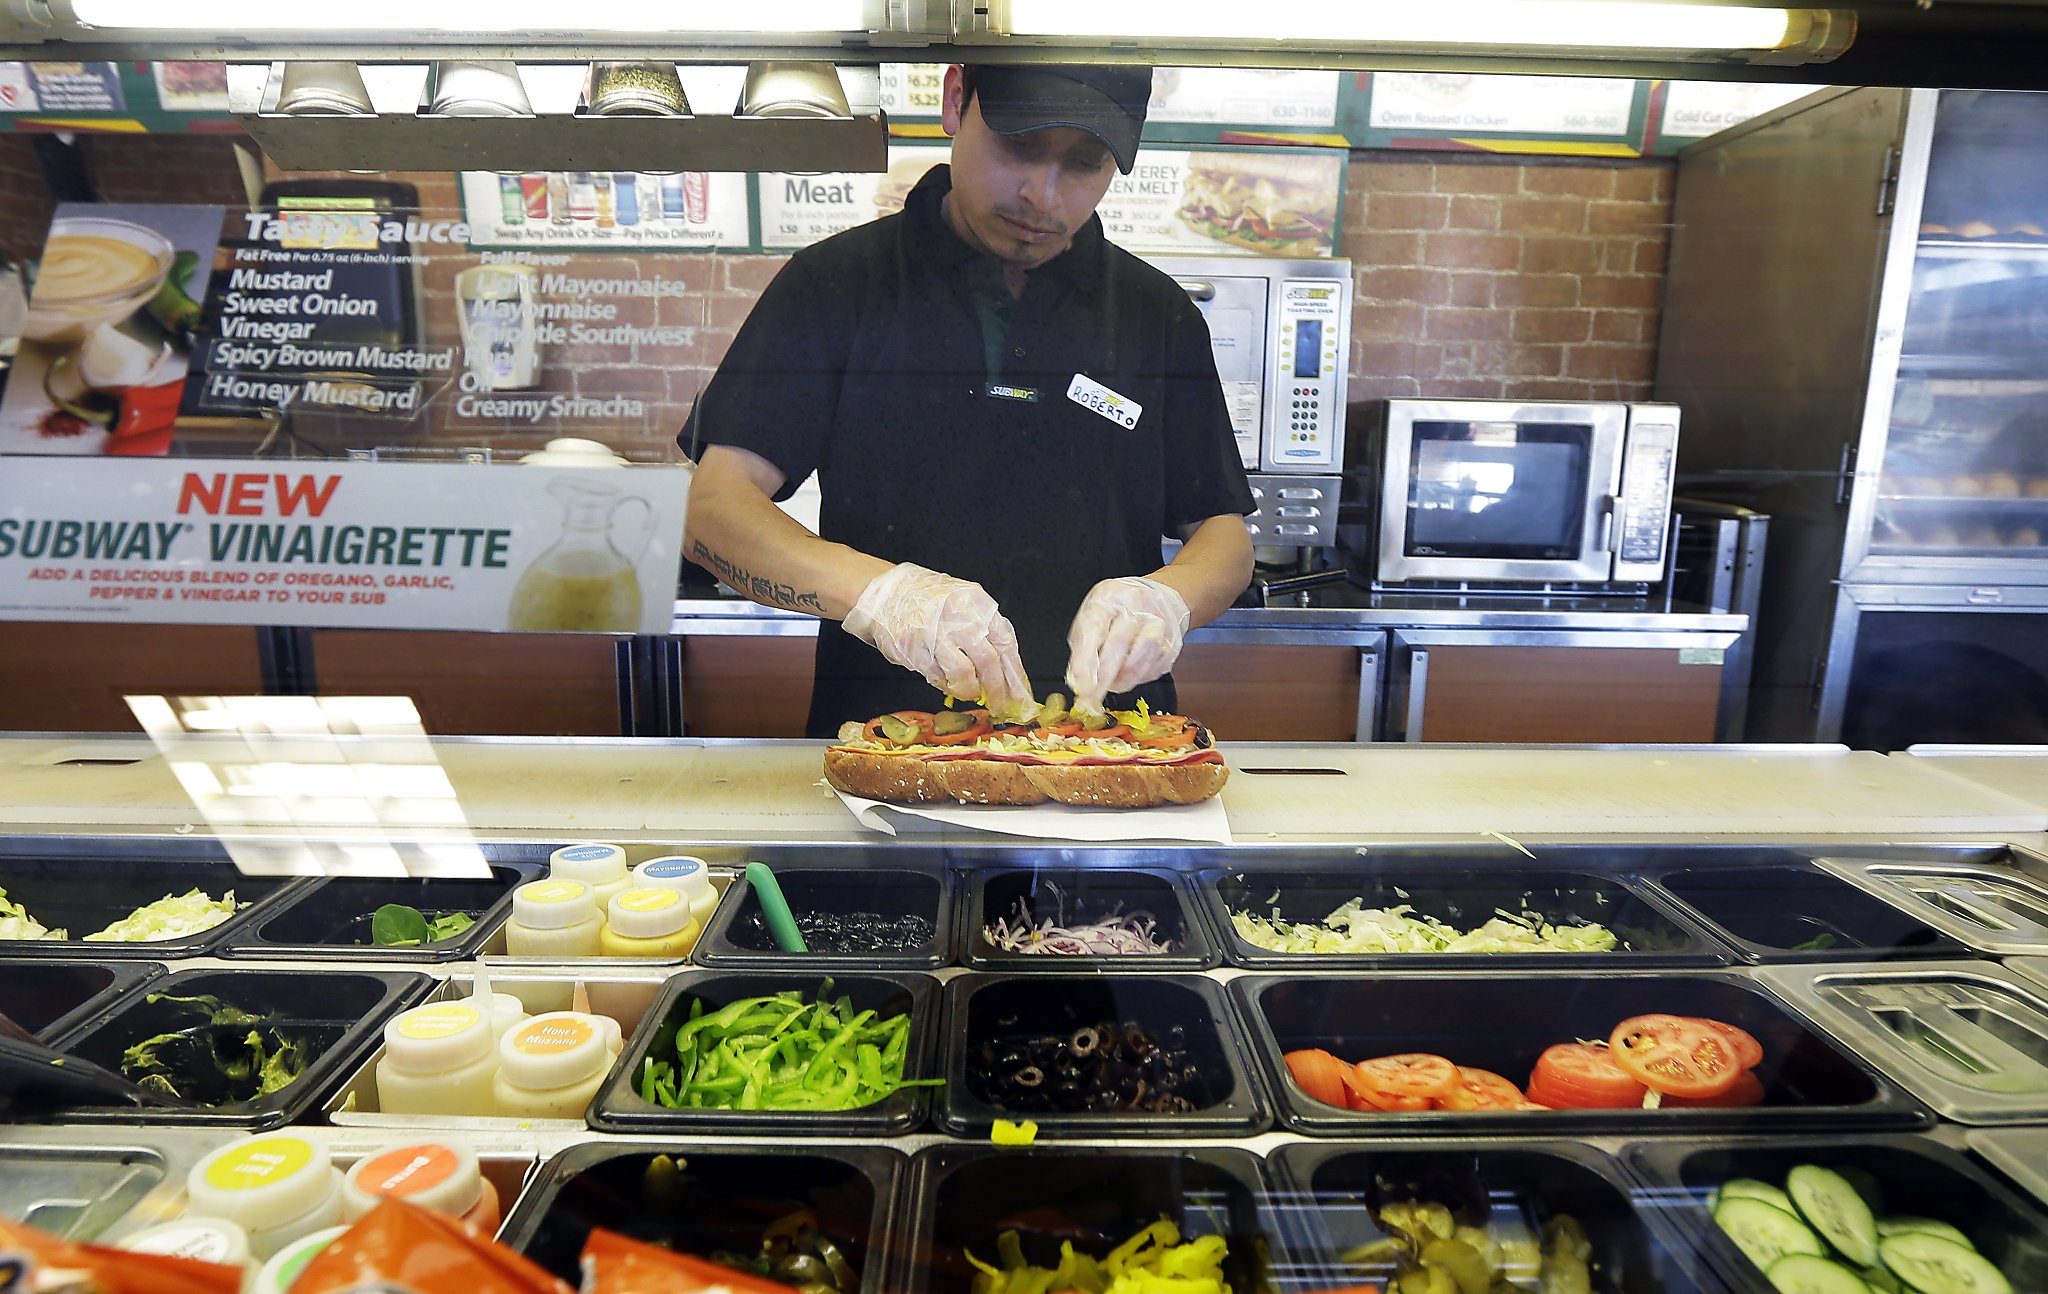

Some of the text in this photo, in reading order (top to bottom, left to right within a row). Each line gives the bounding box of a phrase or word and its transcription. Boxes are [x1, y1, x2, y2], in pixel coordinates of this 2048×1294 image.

[1381, 110, 1508, 127] Oven Roasted Chicken
[1674, 110, 1699, 122] Cold
[1702, 111, 1722, 123] Cut
[1120, 165, 1179, 179] TEREY
[785, 178, 854, 204] Meat
[1139, 181, 1179, 194] MELT
[245, 213, 348, 249] Tasty
[235, 248, 258, 262] Fat
[260, 249, 291, 262] Free
[391, 255, 430, 266] serving
[480, 251, 572, 266] Full Flavor
[229, 268, 334, 291] Mustard
[541, 274, 686, 298] Mayonnaise
[223, 292, 378, 317] Sweet Onion
[220, 316, 317, 343] Vinegar
[470, 321, 696, 347] Chiptle Southwest
[215, 342, 278, 371] Spicy
[277, 347, 358, 368] Brown
[355, 345, 453, 371] Mustard
[210, 374, 417, 410] Honey Mustard
[990, 386, 1034, 399] SUBWAY
[457, 393, 644, 422] Creamy Sriracha
[1073, 385, 1135, 426] ROBERTO
[176, 472, 343, 517] NEW
[209, 523, 511, 568] VINAIGRETTE
[28, 567, 456, 591] ADD A DELICIOUS BLEND OF OREGANO, GARLIC,
[89, 586, 386, 605] PEPPER & VINEGAR TO YOUR SUB
[525, 1035, 577, 1045] MUSTARD
